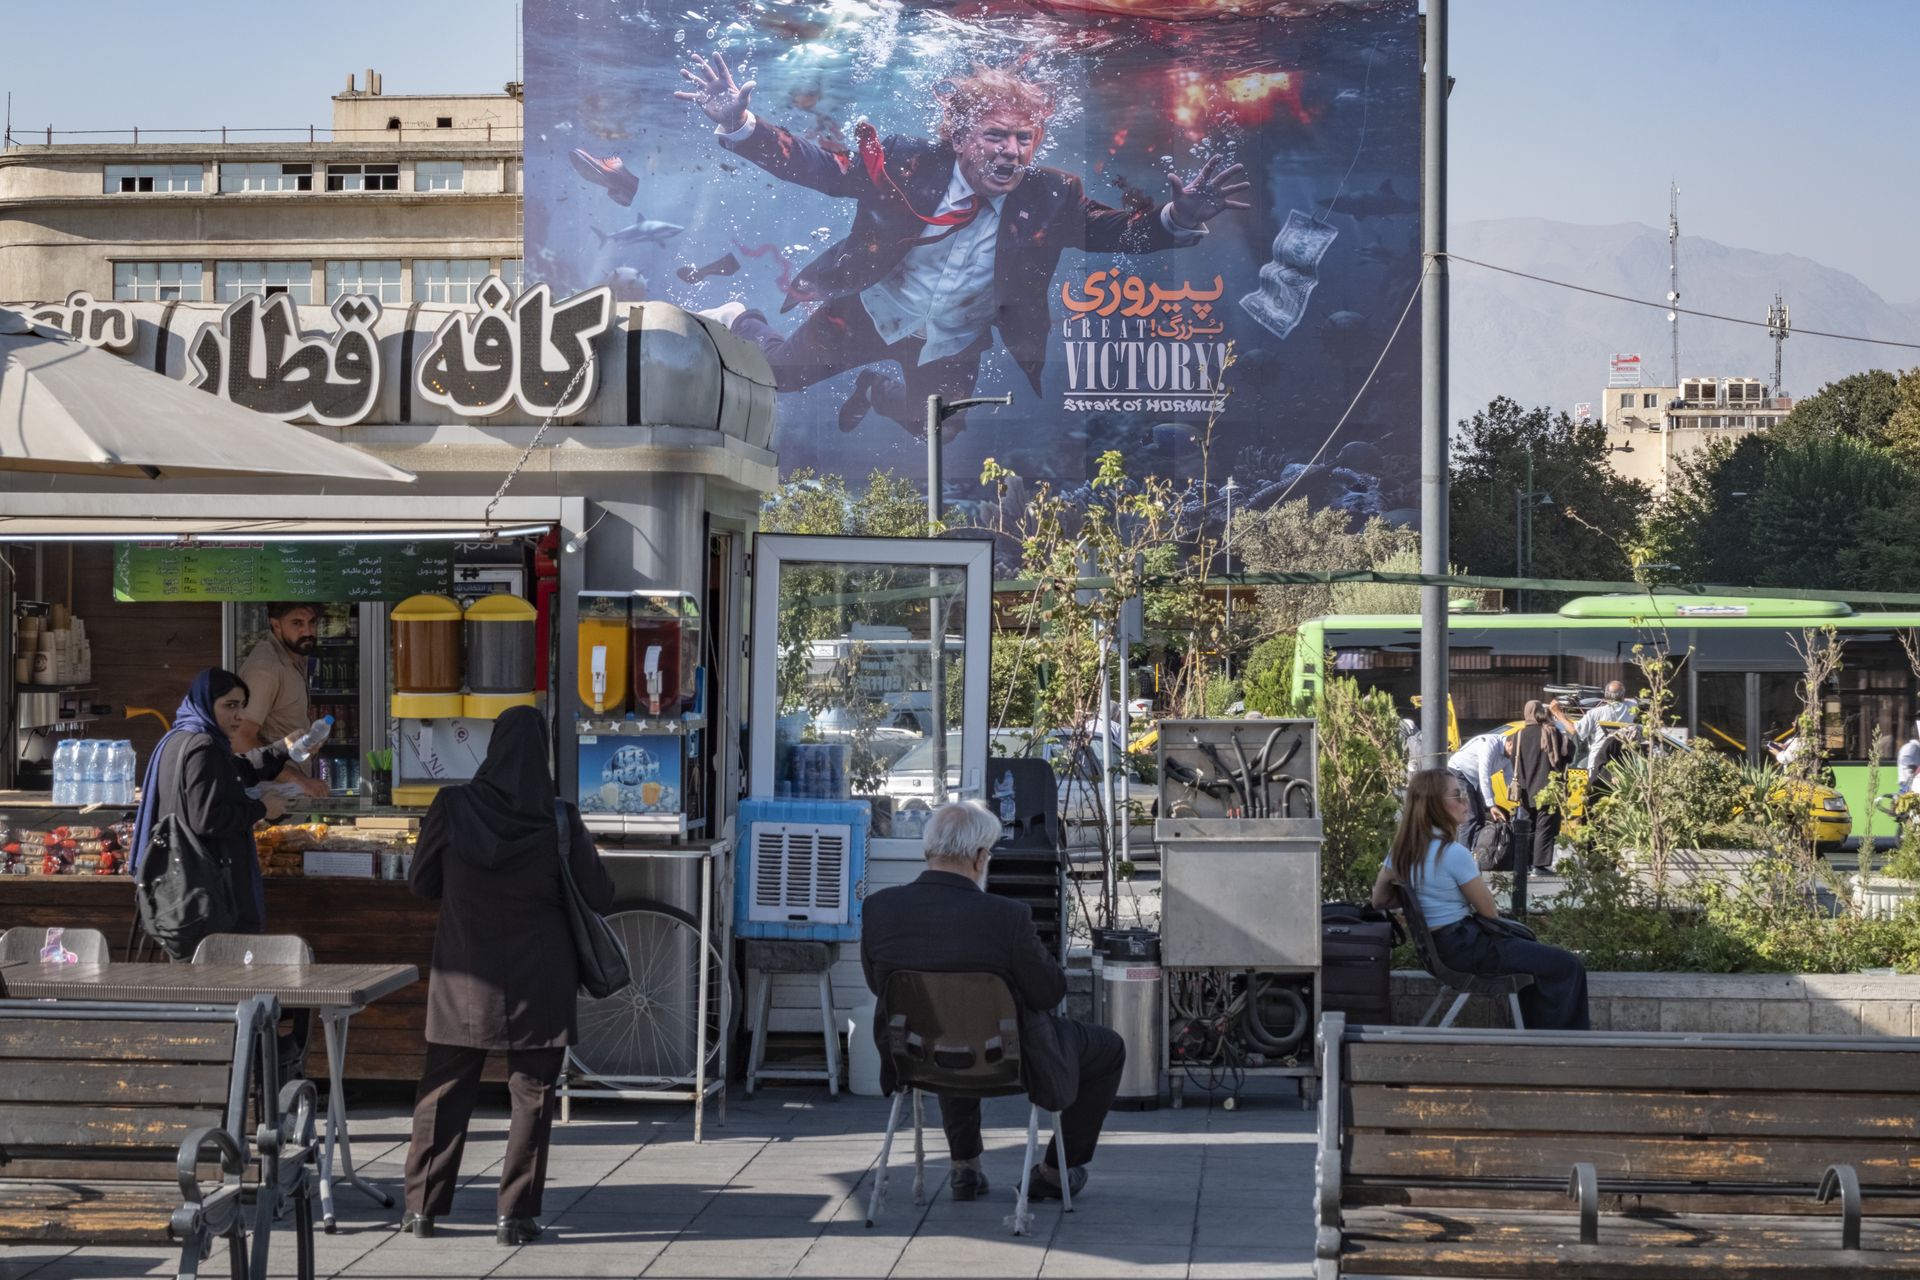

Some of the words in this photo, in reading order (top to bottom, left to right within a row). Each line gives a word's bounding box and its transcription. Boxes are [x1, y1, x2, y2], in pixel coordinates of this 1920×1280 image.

[420, 279, 611, 414] کافه
[1063, 318, 1147, 338] GREAT
[189, 293, 378, 422] قطار
[1063, 341, 1226, 391] VICTORY!
[1063, 398, 1122, 412] Strait
[1123, 398, 1142, 411] of
